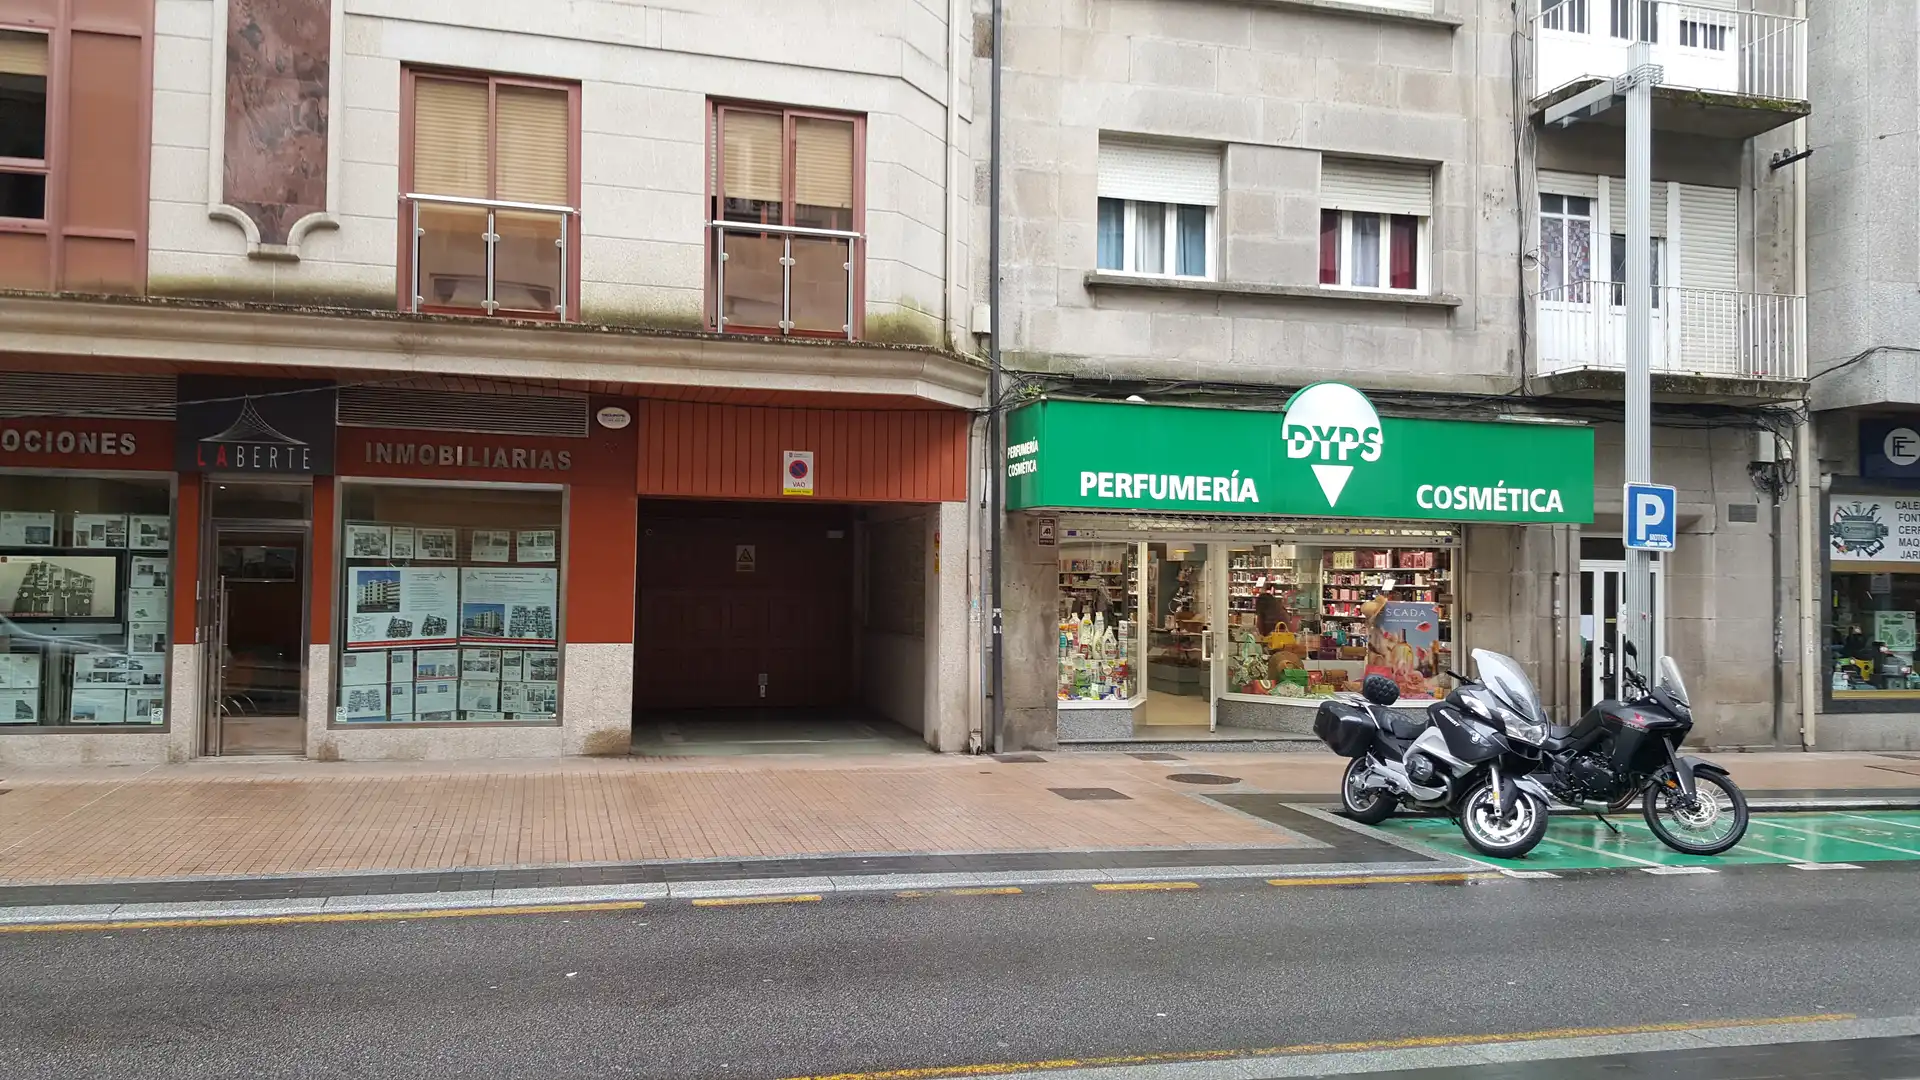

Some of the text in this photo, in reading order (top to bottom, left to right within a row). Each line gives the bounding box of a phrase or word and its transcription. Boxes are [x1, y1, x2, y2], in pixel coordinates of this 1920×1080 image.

[1, 429, 137, 455] OCIONES
[365, 441, 572, 471] INMOBILIARIAS
[1007, 436, 1039, 459] PERFUMERÍA
[1287, 423, 1382, 462] DYPS
[1008, 457, 1037, 477] COSMÉTICA
[1080, 469, 1259, 503] PERFUMERÍA
[1416, 480, 1564, 513] COSMÉTICA
[1637, 493, 1665, 541] P
[1900, 550, 1920, 559] JAR
[1382, 608, 1426, 617] SCADA
